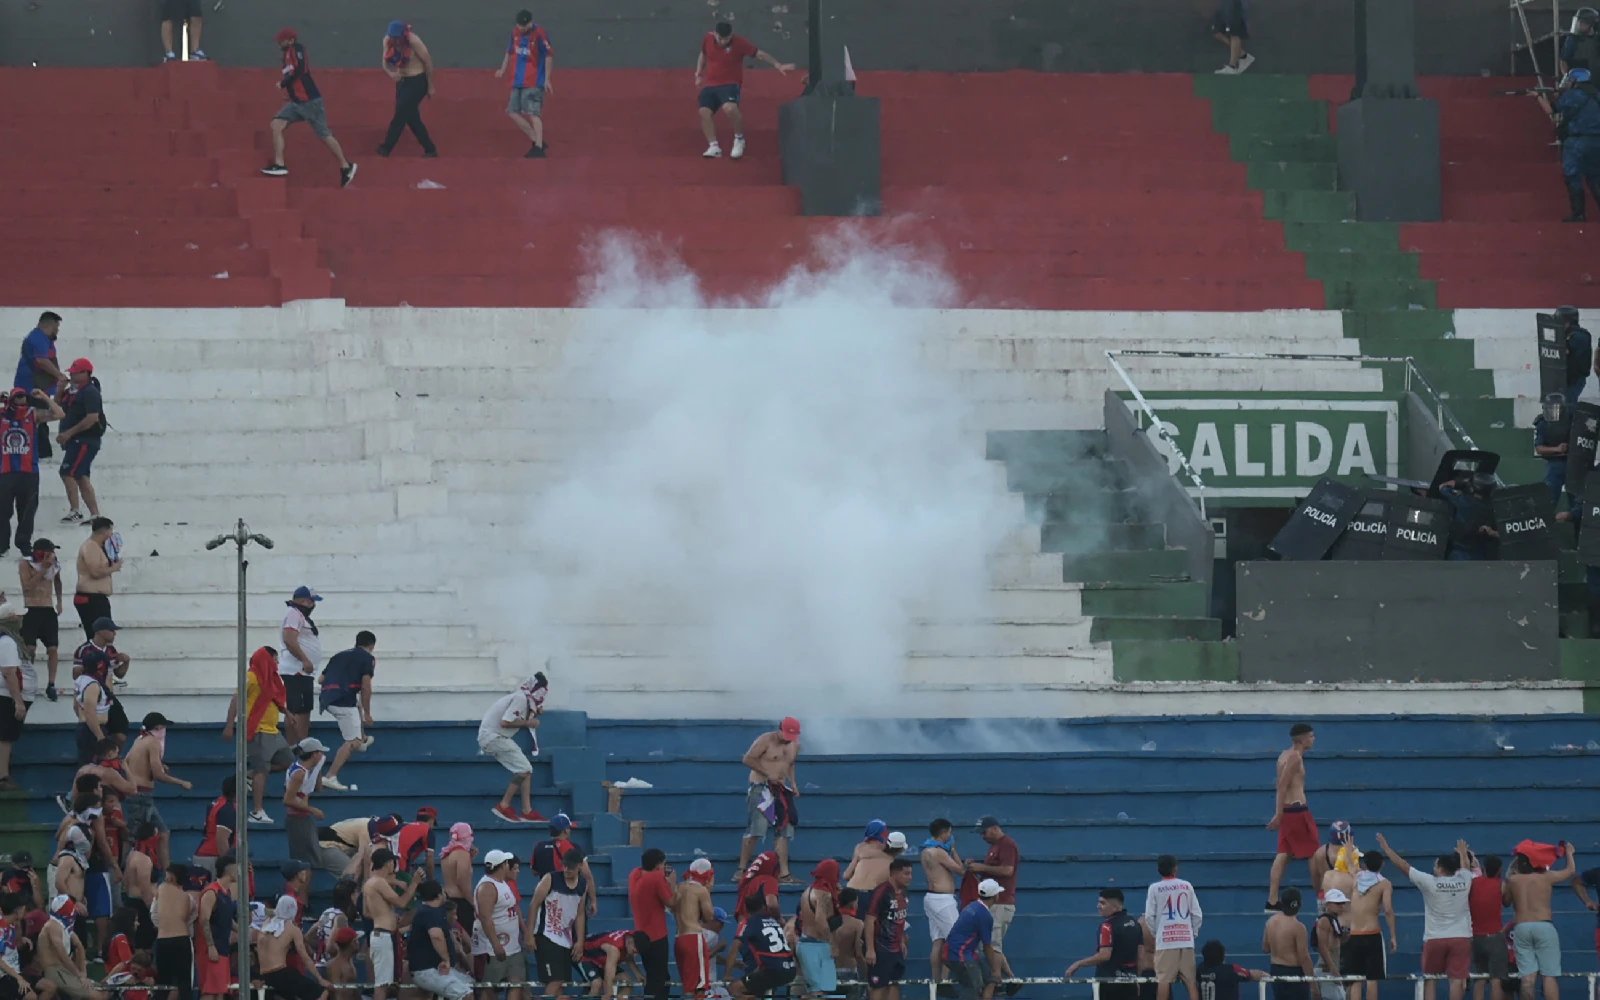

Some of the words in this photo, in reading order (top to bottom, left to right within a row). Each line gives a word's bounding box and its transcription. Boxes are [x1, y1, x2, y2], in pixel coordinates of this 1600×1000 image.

[1146, 421, 1378, 477] SALIDA
[1303, 506, 1338, 528] POLICÍA
[1506, 516, 1547, 534] POLICÍA
[1396, 528, 1438, 545] POLICÍA
